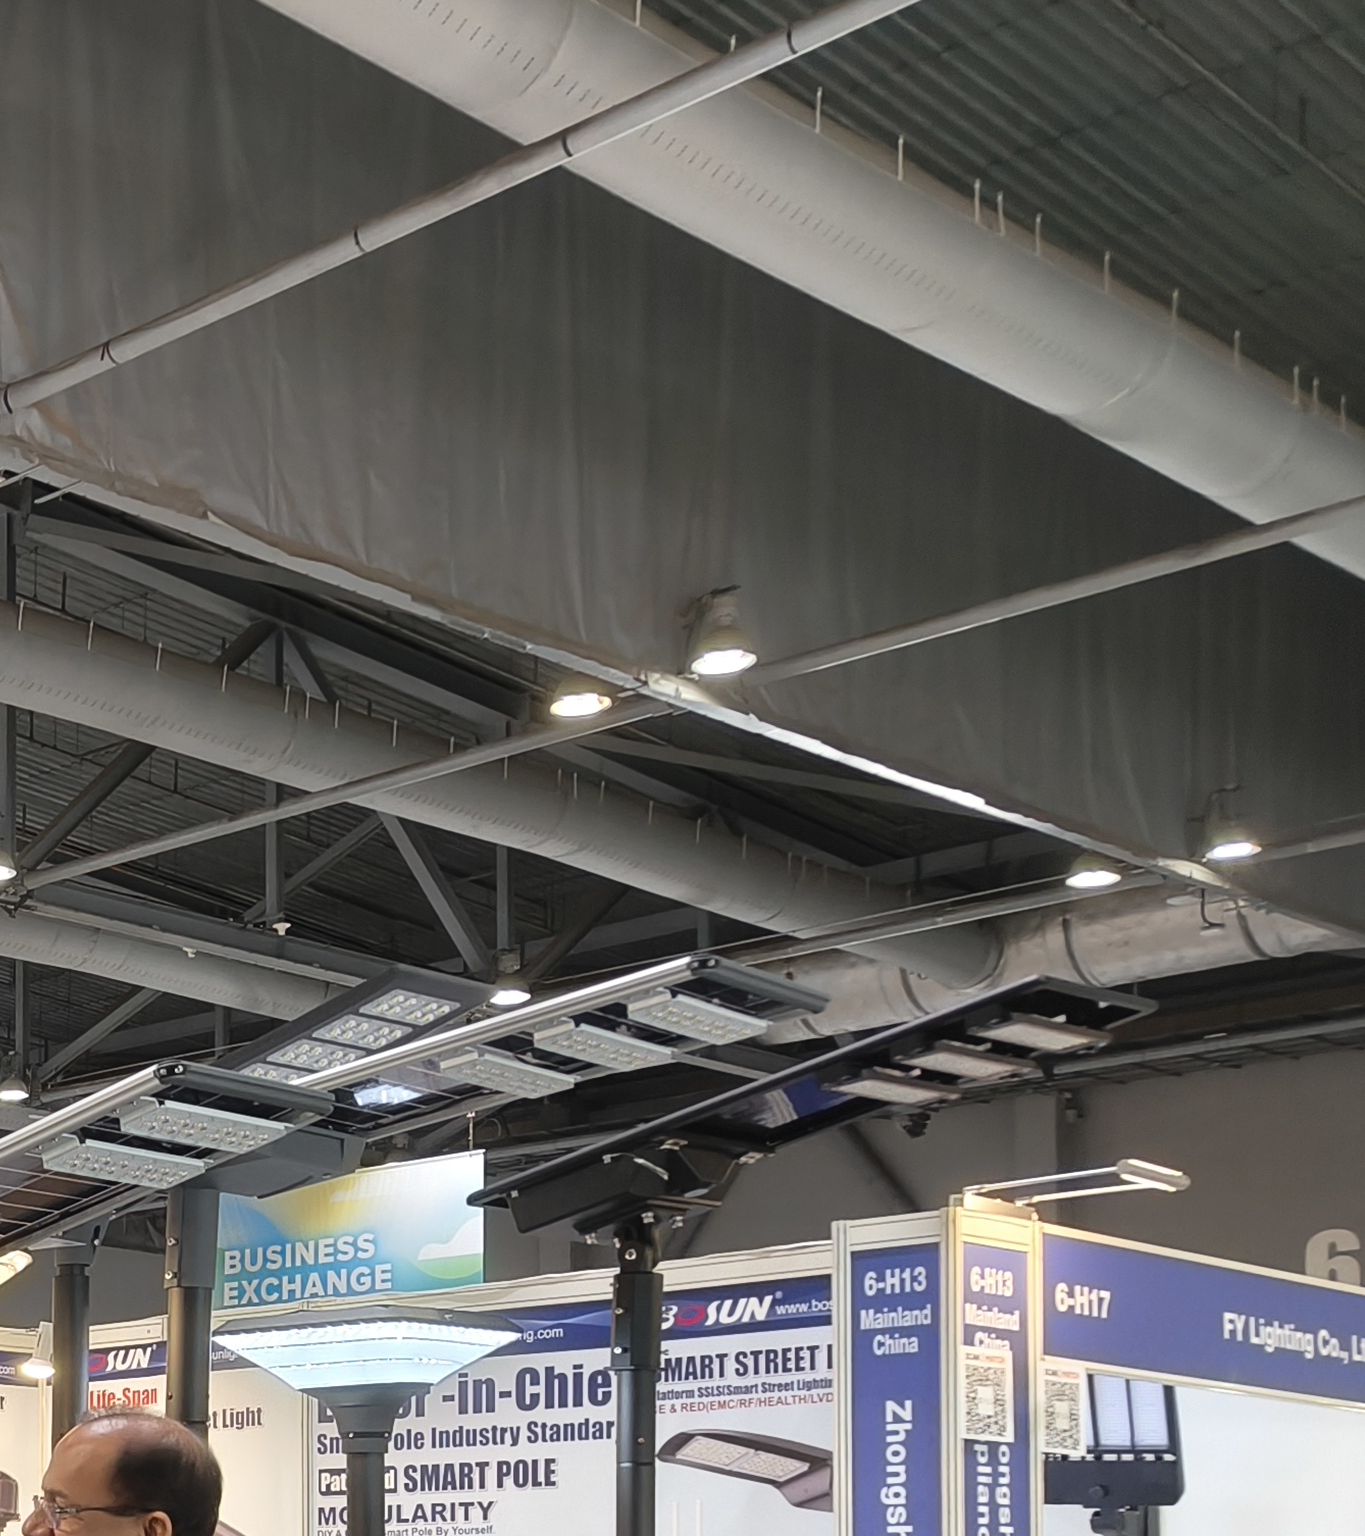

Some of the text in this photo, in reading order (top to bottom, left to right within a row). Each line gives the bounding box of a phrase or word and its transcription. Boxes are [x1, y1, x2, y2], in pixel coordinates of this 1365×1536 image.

[224, 1233, 376, 1275] BUSINESS
[1305, 1228, 1361, 1286] 6
[223, 1263, 393, 1306] EXCHANGE
[864, 1266, 927, 1296] 6-H13
[970, 1266, 1013, 1297] 6-H13
[1054, 1283, 1111, 1319] 6-H17
[860, 1304, 931, 1330] Mainland
[965, 1302, 1019, 1331] Mainland
[873, 1334, 919, 1355] China
[974, 1331, 1010, 1350] China
[1223, 1312, 1365, 1364] FY Lighting Co., Lt
[88, 1347, 152, 1372] OSUN
[735, 1345, 820, 1377] STREET
[89, 1387, 158, 1410] Life-Span
[442, 1364, 612, 1415] -in-Chie
[657, 1377, 833, 1401] latform SSLS(Smart Street Lightin
[669, 1404, 677, 1413] &
[680, 1392, 834, 1414] RED(EMC/RF/HEALTH/LVD
[222, 1407, 263, 1430] Light
[393, 1418, 615, 1450] ole Industry Standar
[404, 1461, 490, 1492] SMART
[496, 1458, 557, 1489] POLE
[385, 1528, 409, 1536] mart
[411, 1527, 433, 1536] Pole
